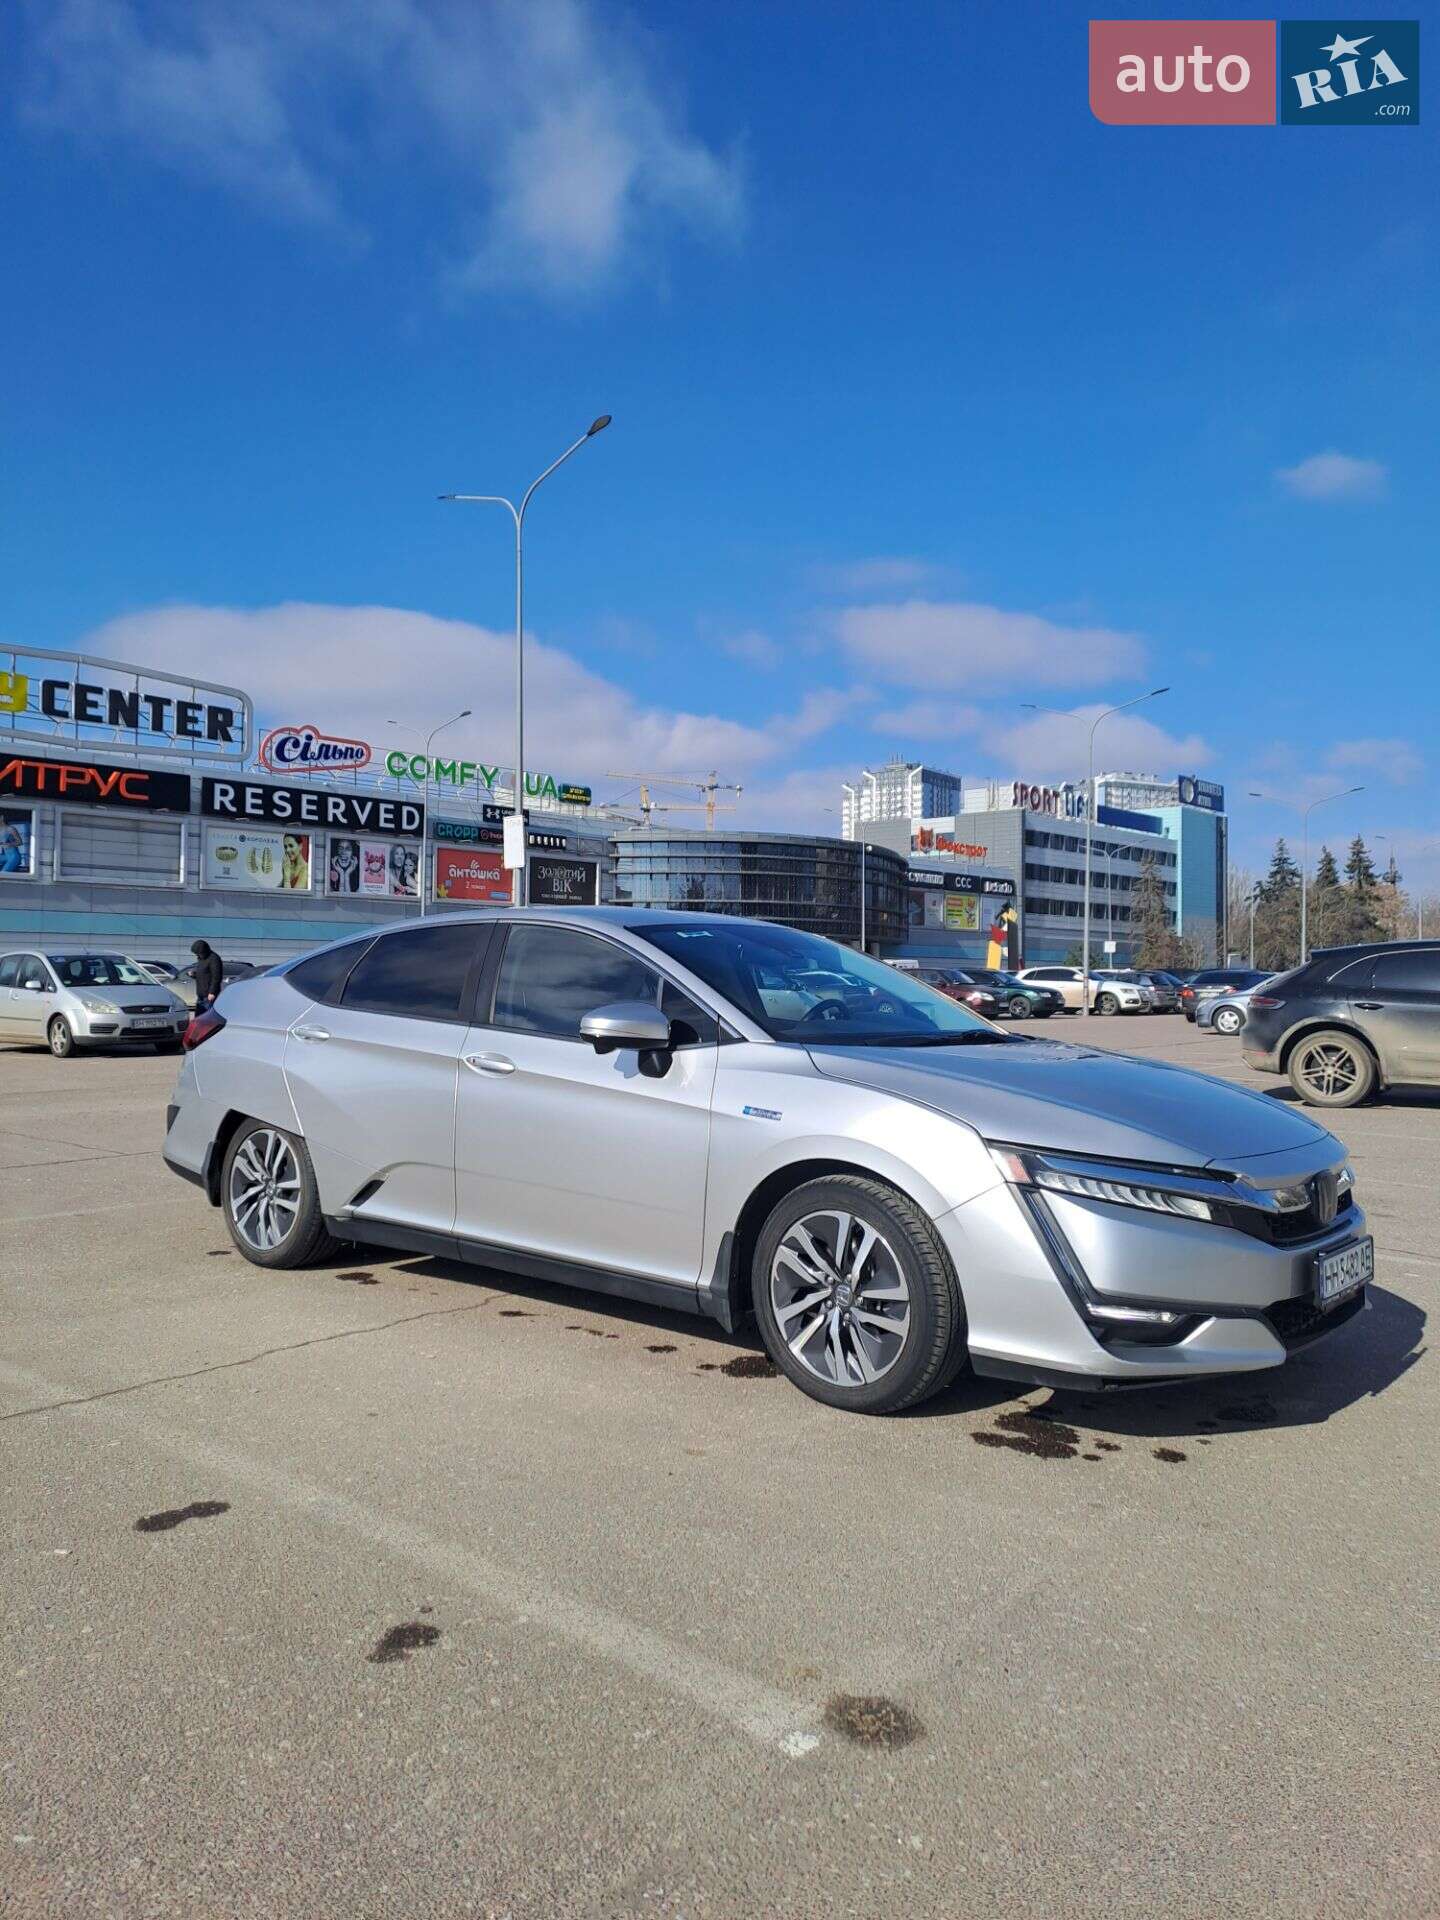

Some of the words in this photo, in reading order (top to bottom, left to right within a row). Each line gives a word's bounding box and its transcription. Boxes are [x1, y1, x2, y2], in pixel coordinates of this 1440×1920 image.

[40, 678, 234, 743] CENTER
[274, 734, 365, 763] Сільпо
[385, 750, 499, 789] COMFY
[213, 783, 420, 831] RESERVED
[1012, 781, 1060, 815] SPORT
[438, 823, 479, 839] CROPP
